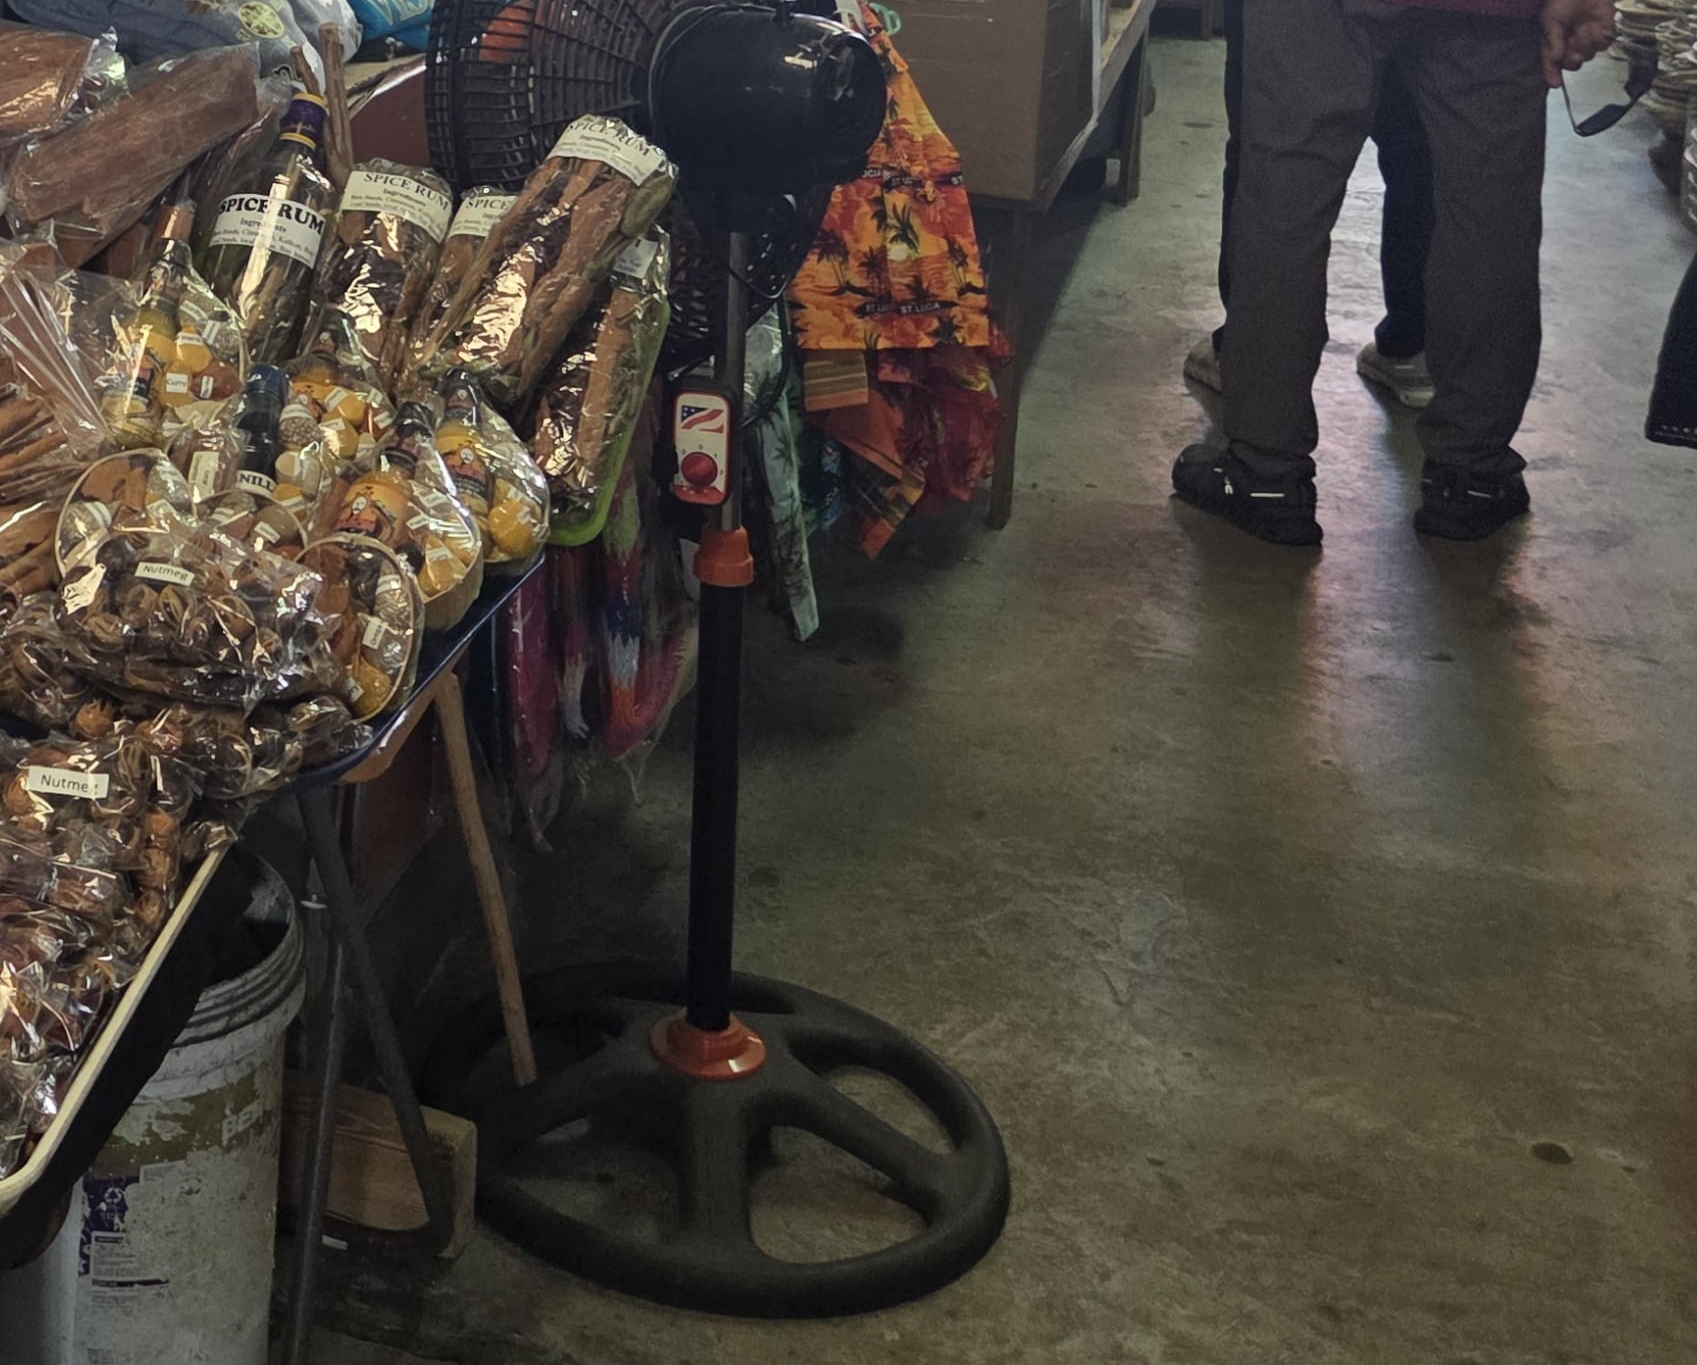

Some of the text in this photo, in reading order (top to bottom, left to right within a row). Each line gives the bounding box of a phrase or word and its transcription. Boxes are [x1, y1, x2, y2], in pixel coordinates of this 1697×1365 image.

[364, 172, 450, 211] SPICE RUM
[277, 203, 325, 236] RUM
[238, 472, 274, 491] NILL
[143, 564, 189, 582] Nutmeg
